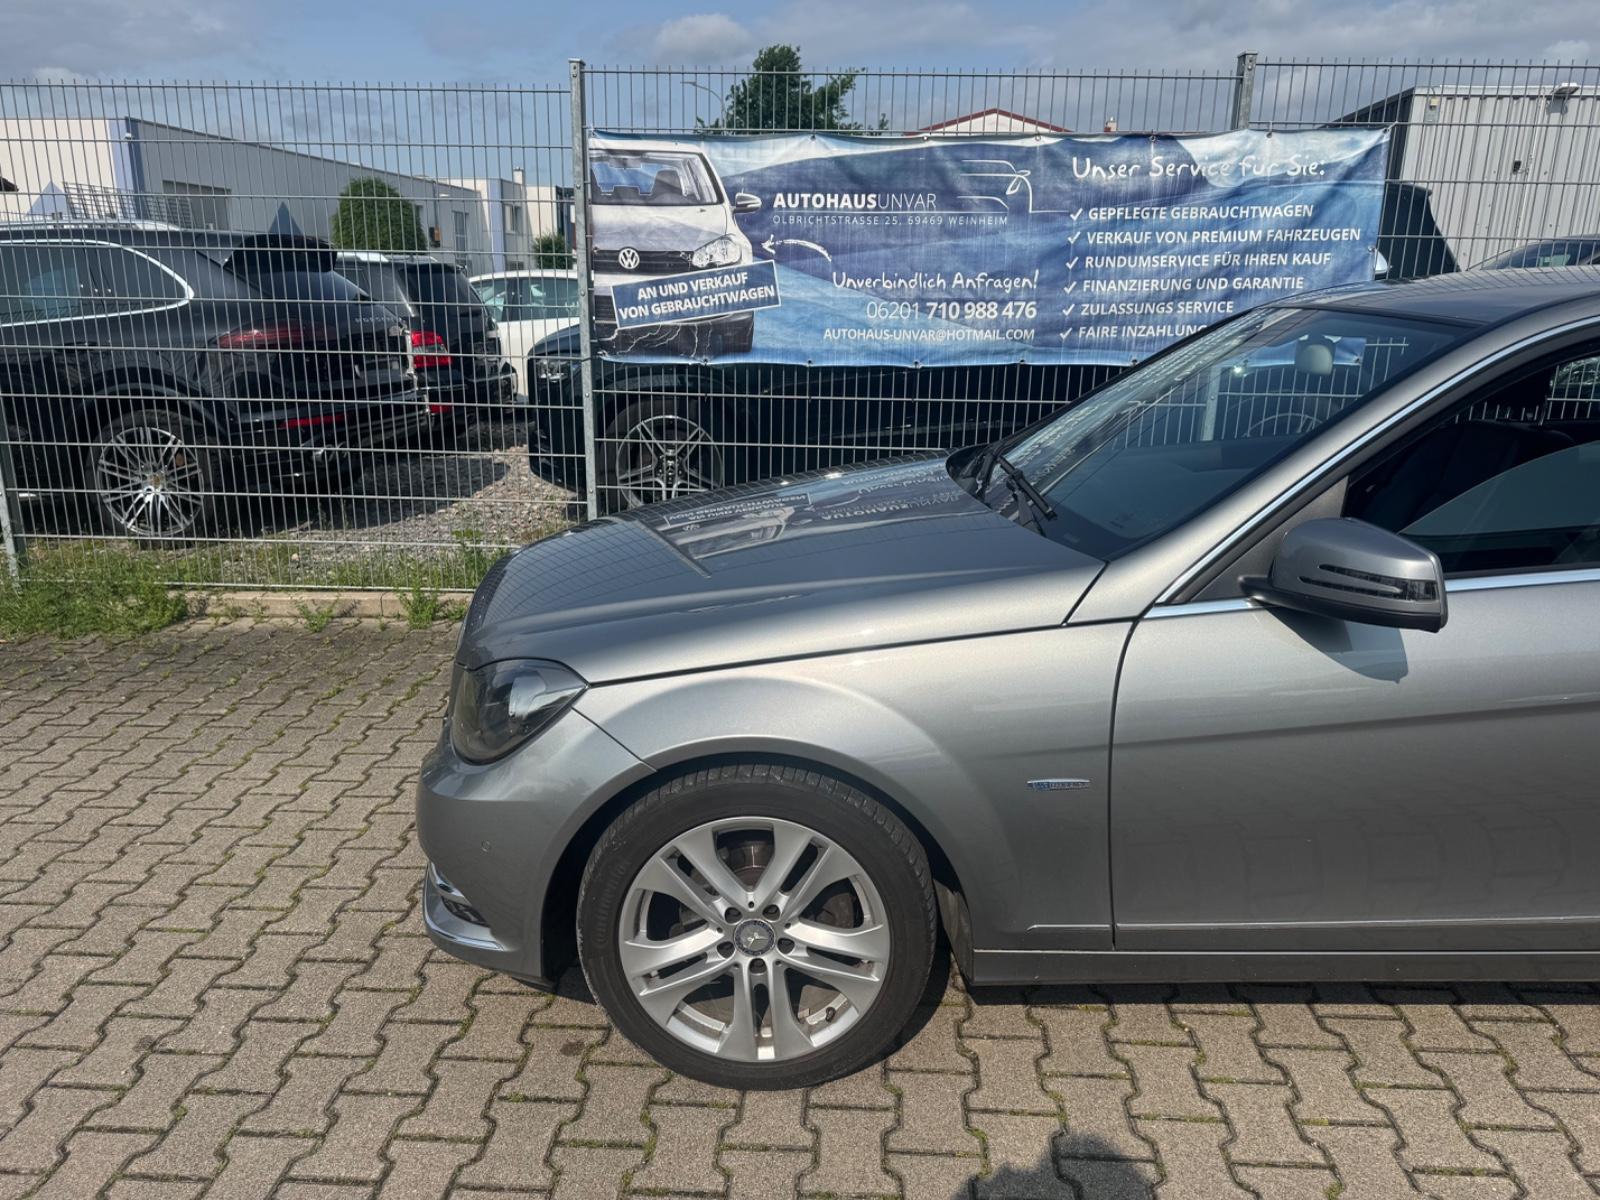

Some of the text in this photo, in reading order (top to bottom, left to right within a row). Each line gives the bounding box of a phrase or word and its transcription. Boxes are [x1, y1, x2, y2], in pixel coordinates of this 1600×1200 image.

[1072, 155, 1325, 179] Unser Service für Sie:
[772, 192, 937, 209] AUTOHAUSUNVAR
[772, 215, 880, 225] OLBRICHTSTRASSE
[908, 215, 943, 225] 69469
[949, 215, 1008, 225] WEINHEIM
[1088, 204, 1314, 221] GEPFLEGTE GEBRAUCHTWAGEN
[1086, 228, 1361, 245] VERKAUF VON PREMIUM FAHRZEUGEN
[1084, 251, 1332, 268] RUNDUMSERVICE FÜR IHREN KAUF
[637, 271, 749, 301] AN UND VERKAUF
[832, 269, 1041, 293] Unverbindlich Anfragen!
[1083, 276, 1304, 293] FINANZIERUNG UND GARANTIE
[619, 285, 775, 320] VON GEBRAUCHTWAGEN
[866, 301, 1038, 320] 06201 710 988 476
[1081, 300, 1234, 316] ZULASSUNGS SERVICE
[823, 328, 1036, 341] AUTOHAUS-UNVAR@HOTMAIL.COM
[1078, 325, 1118, 338] FAIRE
